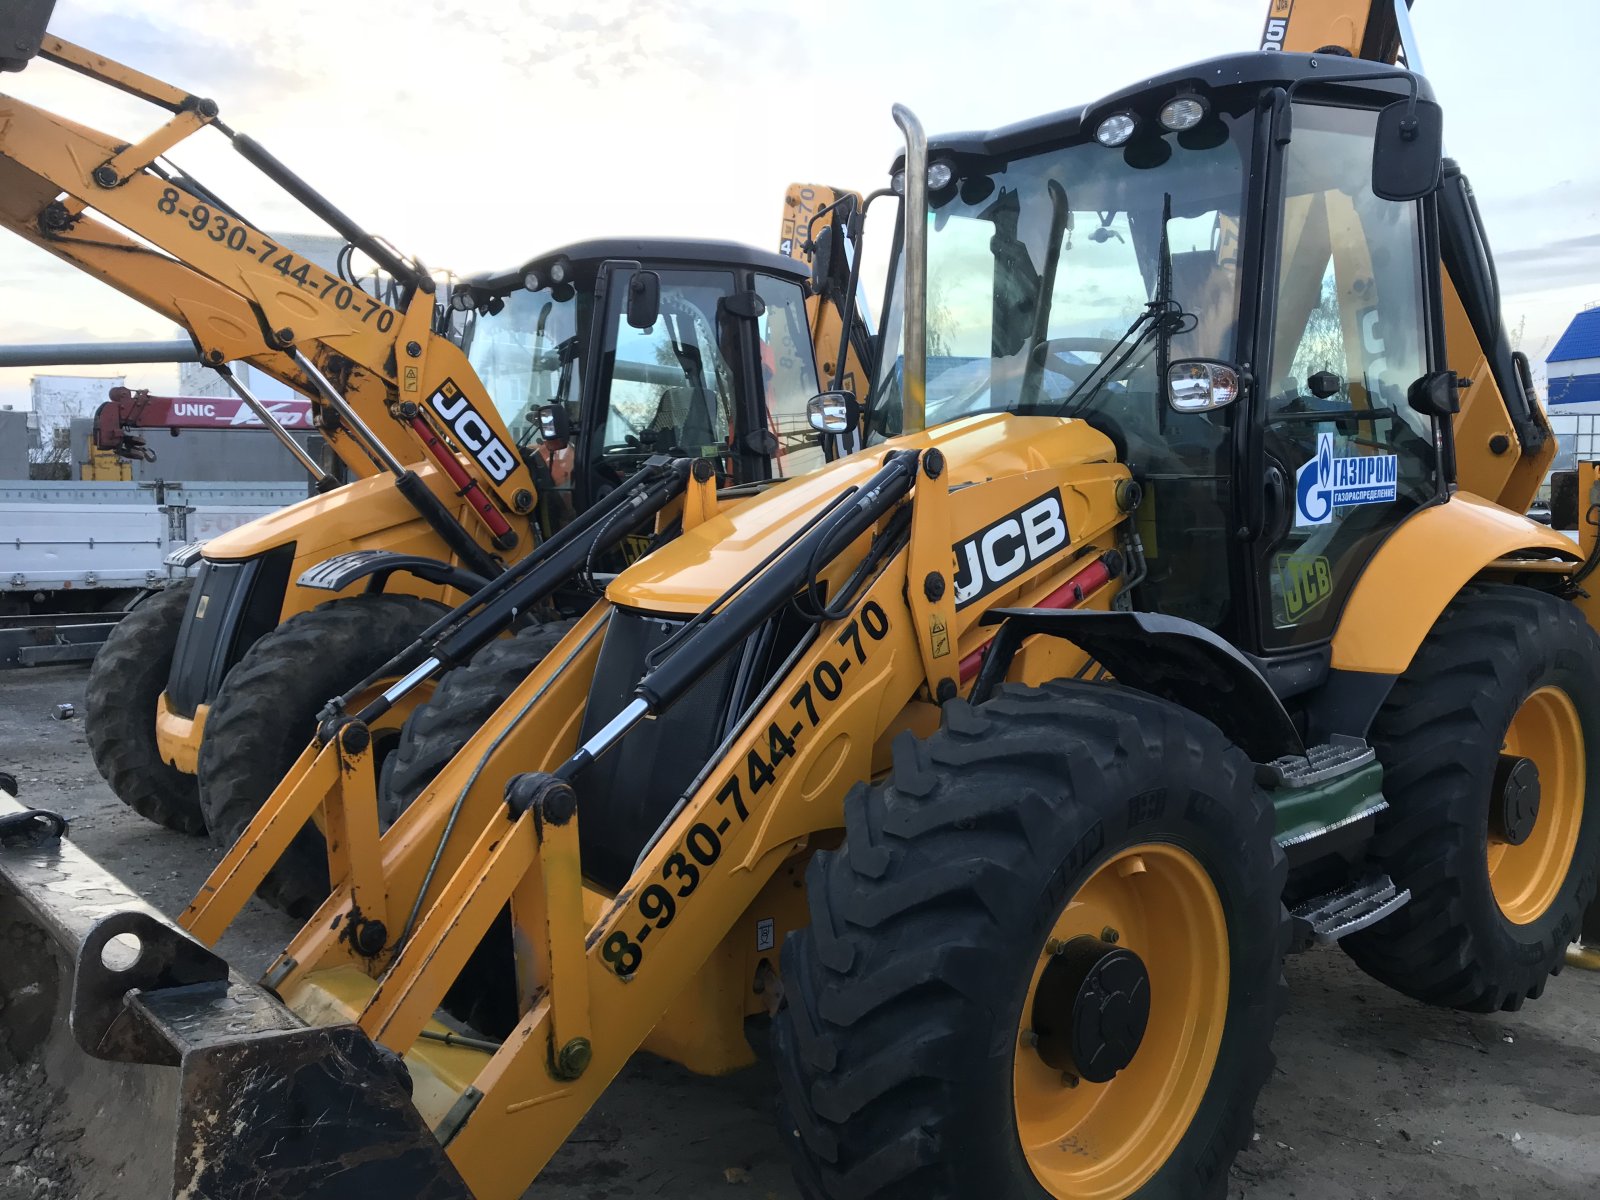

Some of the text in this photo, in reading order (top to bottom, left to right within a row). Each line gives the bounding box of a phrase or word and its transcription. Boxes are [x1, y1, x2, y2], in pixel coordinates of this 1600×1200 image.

[157, 187, 396, 334] 8-930-744-70-70
[174, 403, 216, 417] UNIC
[432, 391, 515, 481] JCB
[1333, 455, 1396, 487] ГАЗПРОМ
[1334, 487, 1395, 502] ГАЗОРАСПРЕДЕЛЕНИЕ
[954, 497, 1066, 605] JCB
[1286, 561, 1330, 614] JCB
[601, 600, 890, 977] 8-930-744-70-70
